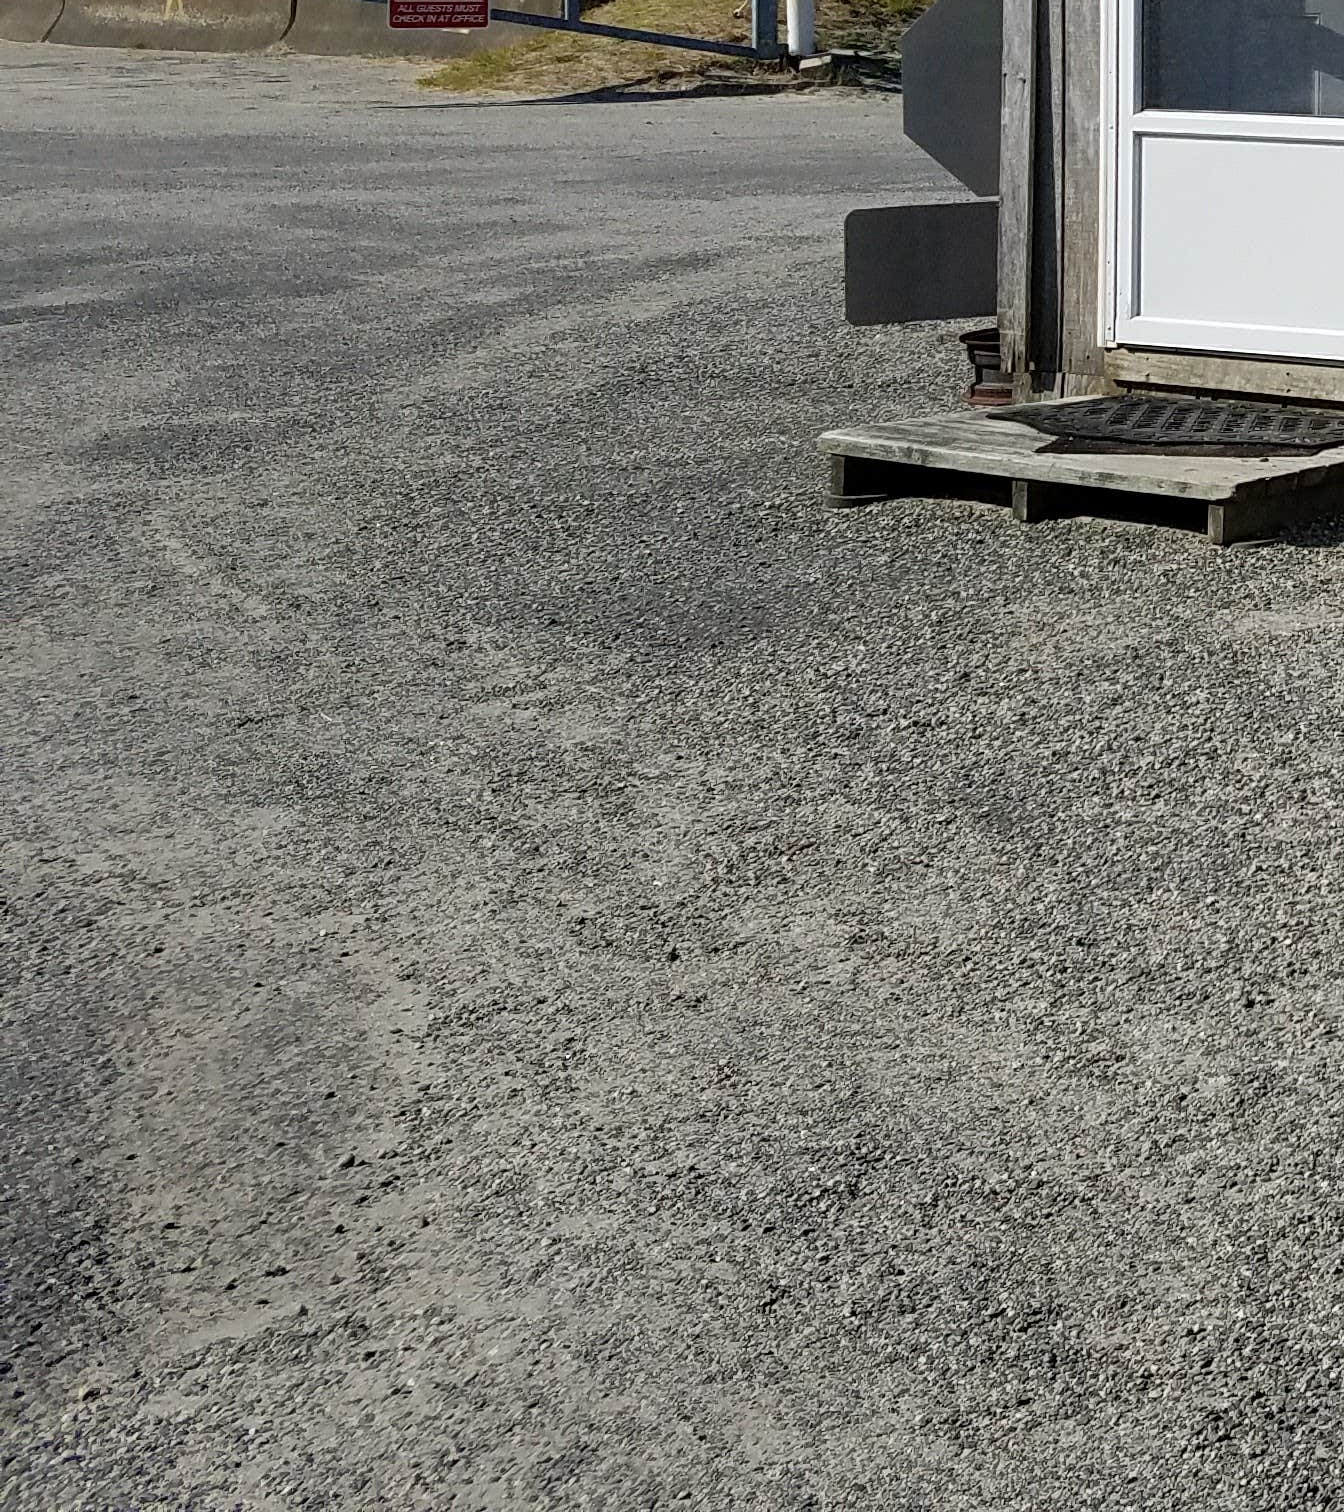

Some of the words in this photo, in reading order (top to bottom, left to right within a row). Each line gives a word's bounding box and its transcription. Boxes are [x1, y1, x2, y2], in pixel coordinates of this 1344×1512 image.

[397, 4, 415, 12] ALL
[416, 4, 453, 12] GUESTS
[454, 4, 482, 12] MUST
[392, 14, 425, 23] CHECK
[426, 14, 437, 22] IN
[438, 14, 451, 22] AT
[451, 14, 485, 23] OFFICE
